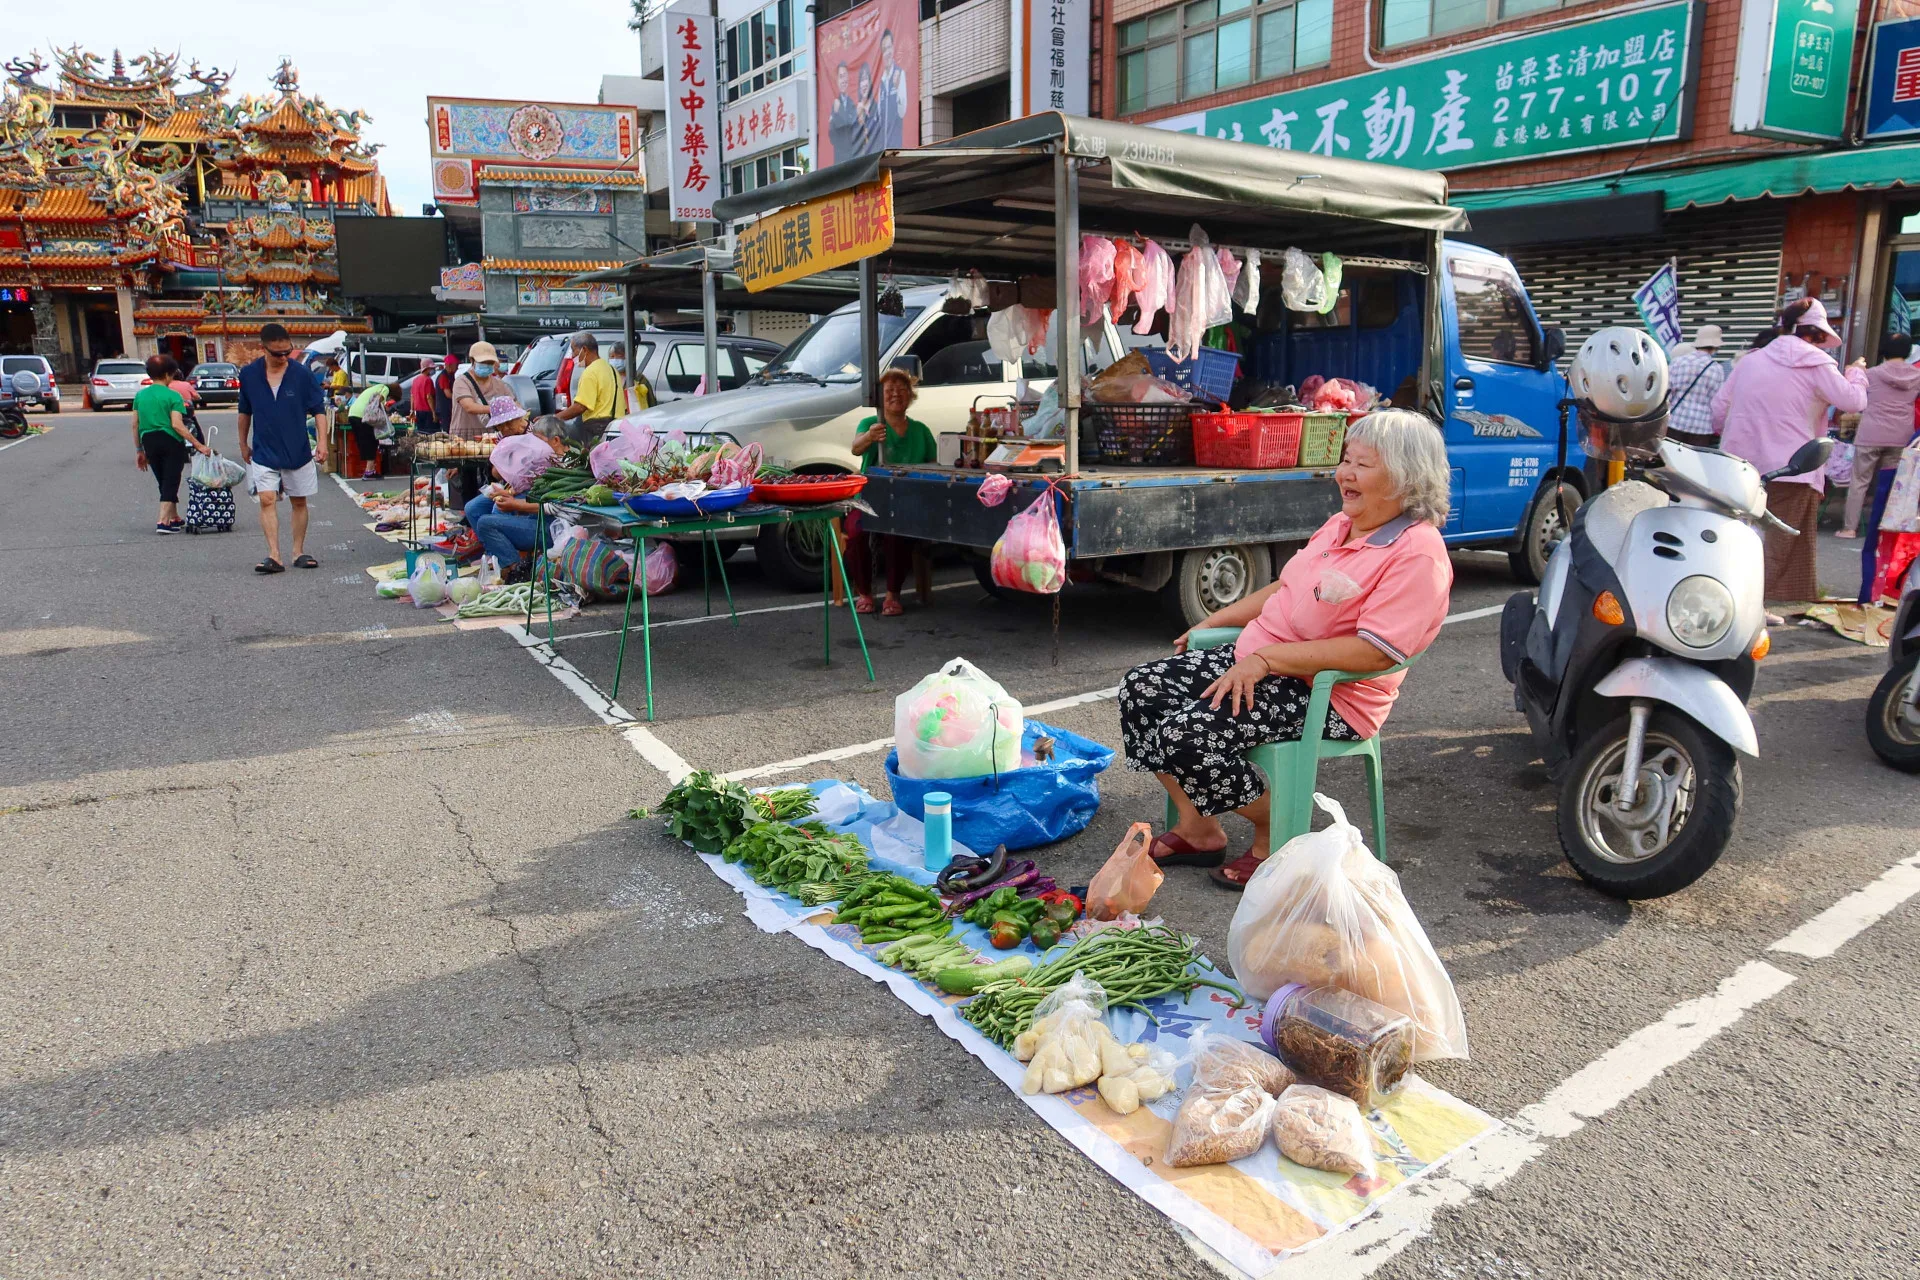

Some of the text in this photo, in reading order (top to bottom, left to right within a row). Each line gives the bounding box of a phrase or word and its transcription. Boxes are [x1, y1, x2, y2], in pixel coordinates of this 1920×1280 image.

[1050, 0, 1066, 109] 社會福利慈
[1495, 28, 1676, 92] 苗栗玉清加盟店
[1793, 73, 1826, 91] 277-107
[676, 17, 710, 193] 生光中藥房
[724, 96, 788, 151] 生光中藥房
[1493, 67, 1673, 124] 277-107
[676, 206, 715, 219] 38038
[820, 186, 890, 256] 高山蔬菜
